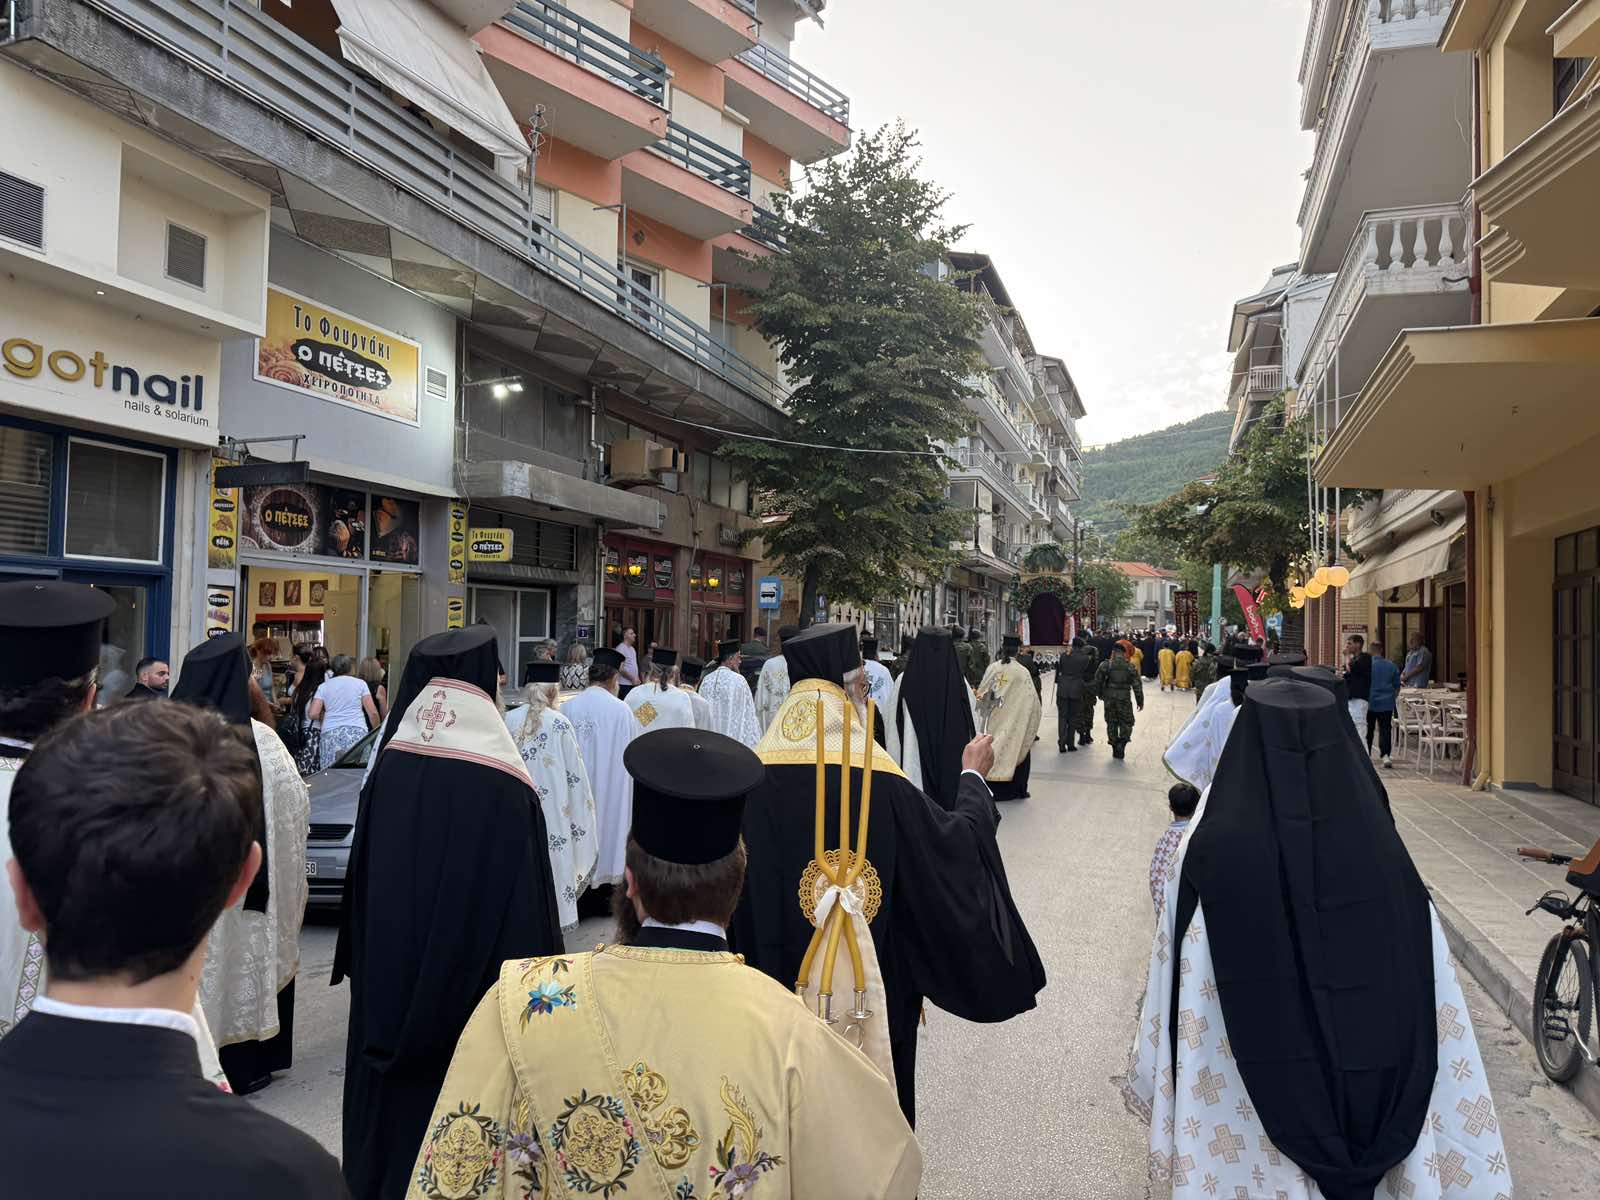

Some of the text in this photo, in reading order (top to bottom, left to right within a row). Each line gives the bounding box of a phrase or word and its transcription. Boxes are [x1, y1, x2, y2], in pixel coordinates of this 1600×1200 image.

[294, 305, 391, 361] Το Φουρνάκι
[2, 338, 204, 412] gotnail
[303, 374, 381, 405] ΧΕΙΡΟΠΟΙΗΤΑ
[124, 399, 210, 427] nails & solarium
